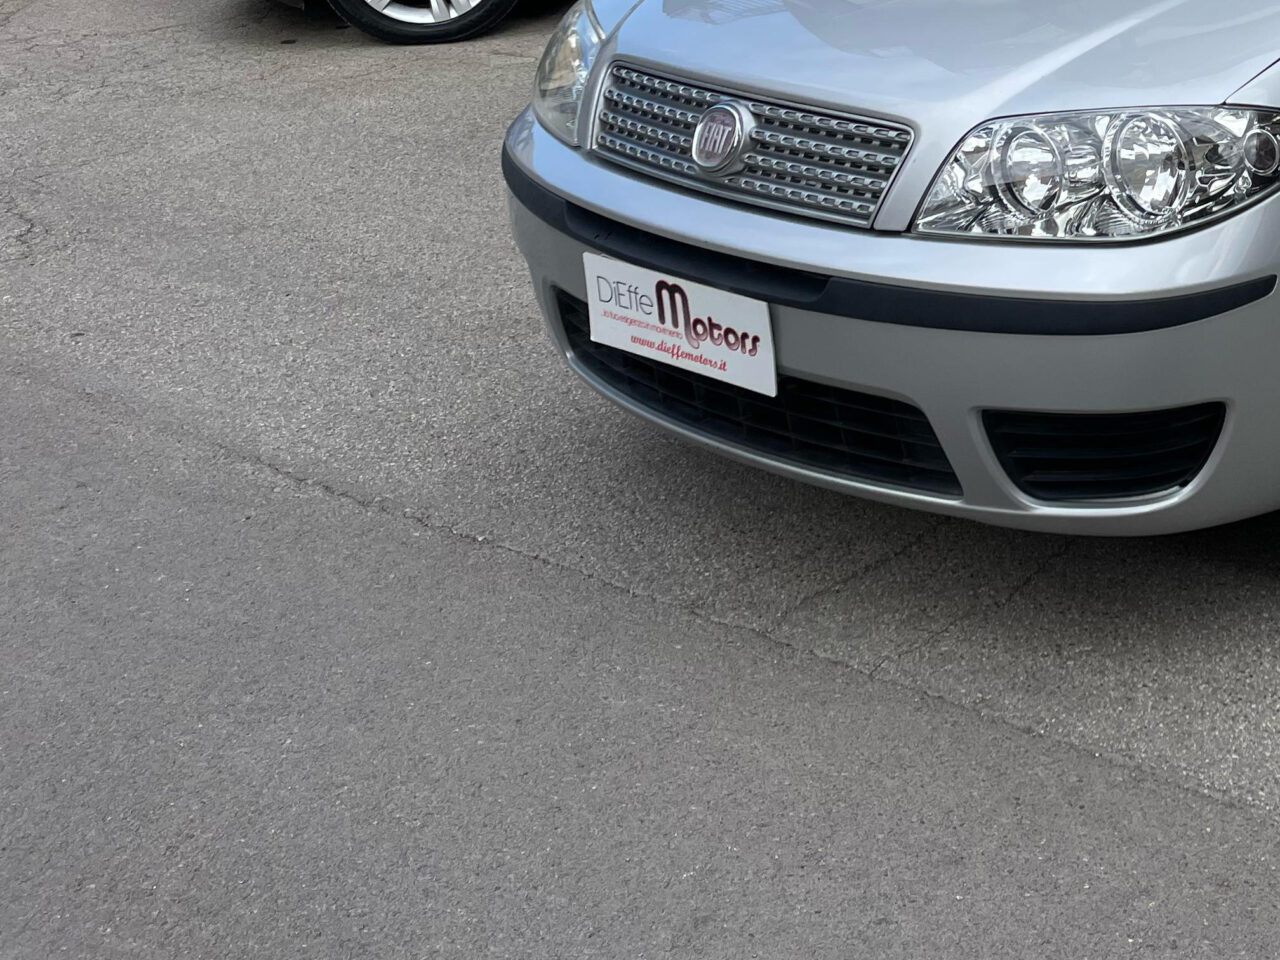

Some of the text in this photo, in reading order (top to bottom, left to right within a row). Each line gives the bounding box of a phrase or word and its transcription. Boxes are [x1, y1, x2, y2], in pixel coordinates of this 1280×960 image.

[700, 121, 732, 154] FIAT
[596, 275, 654, 316] DiEffe
[630, 334, 728, 372] www.dieffemotors.it
